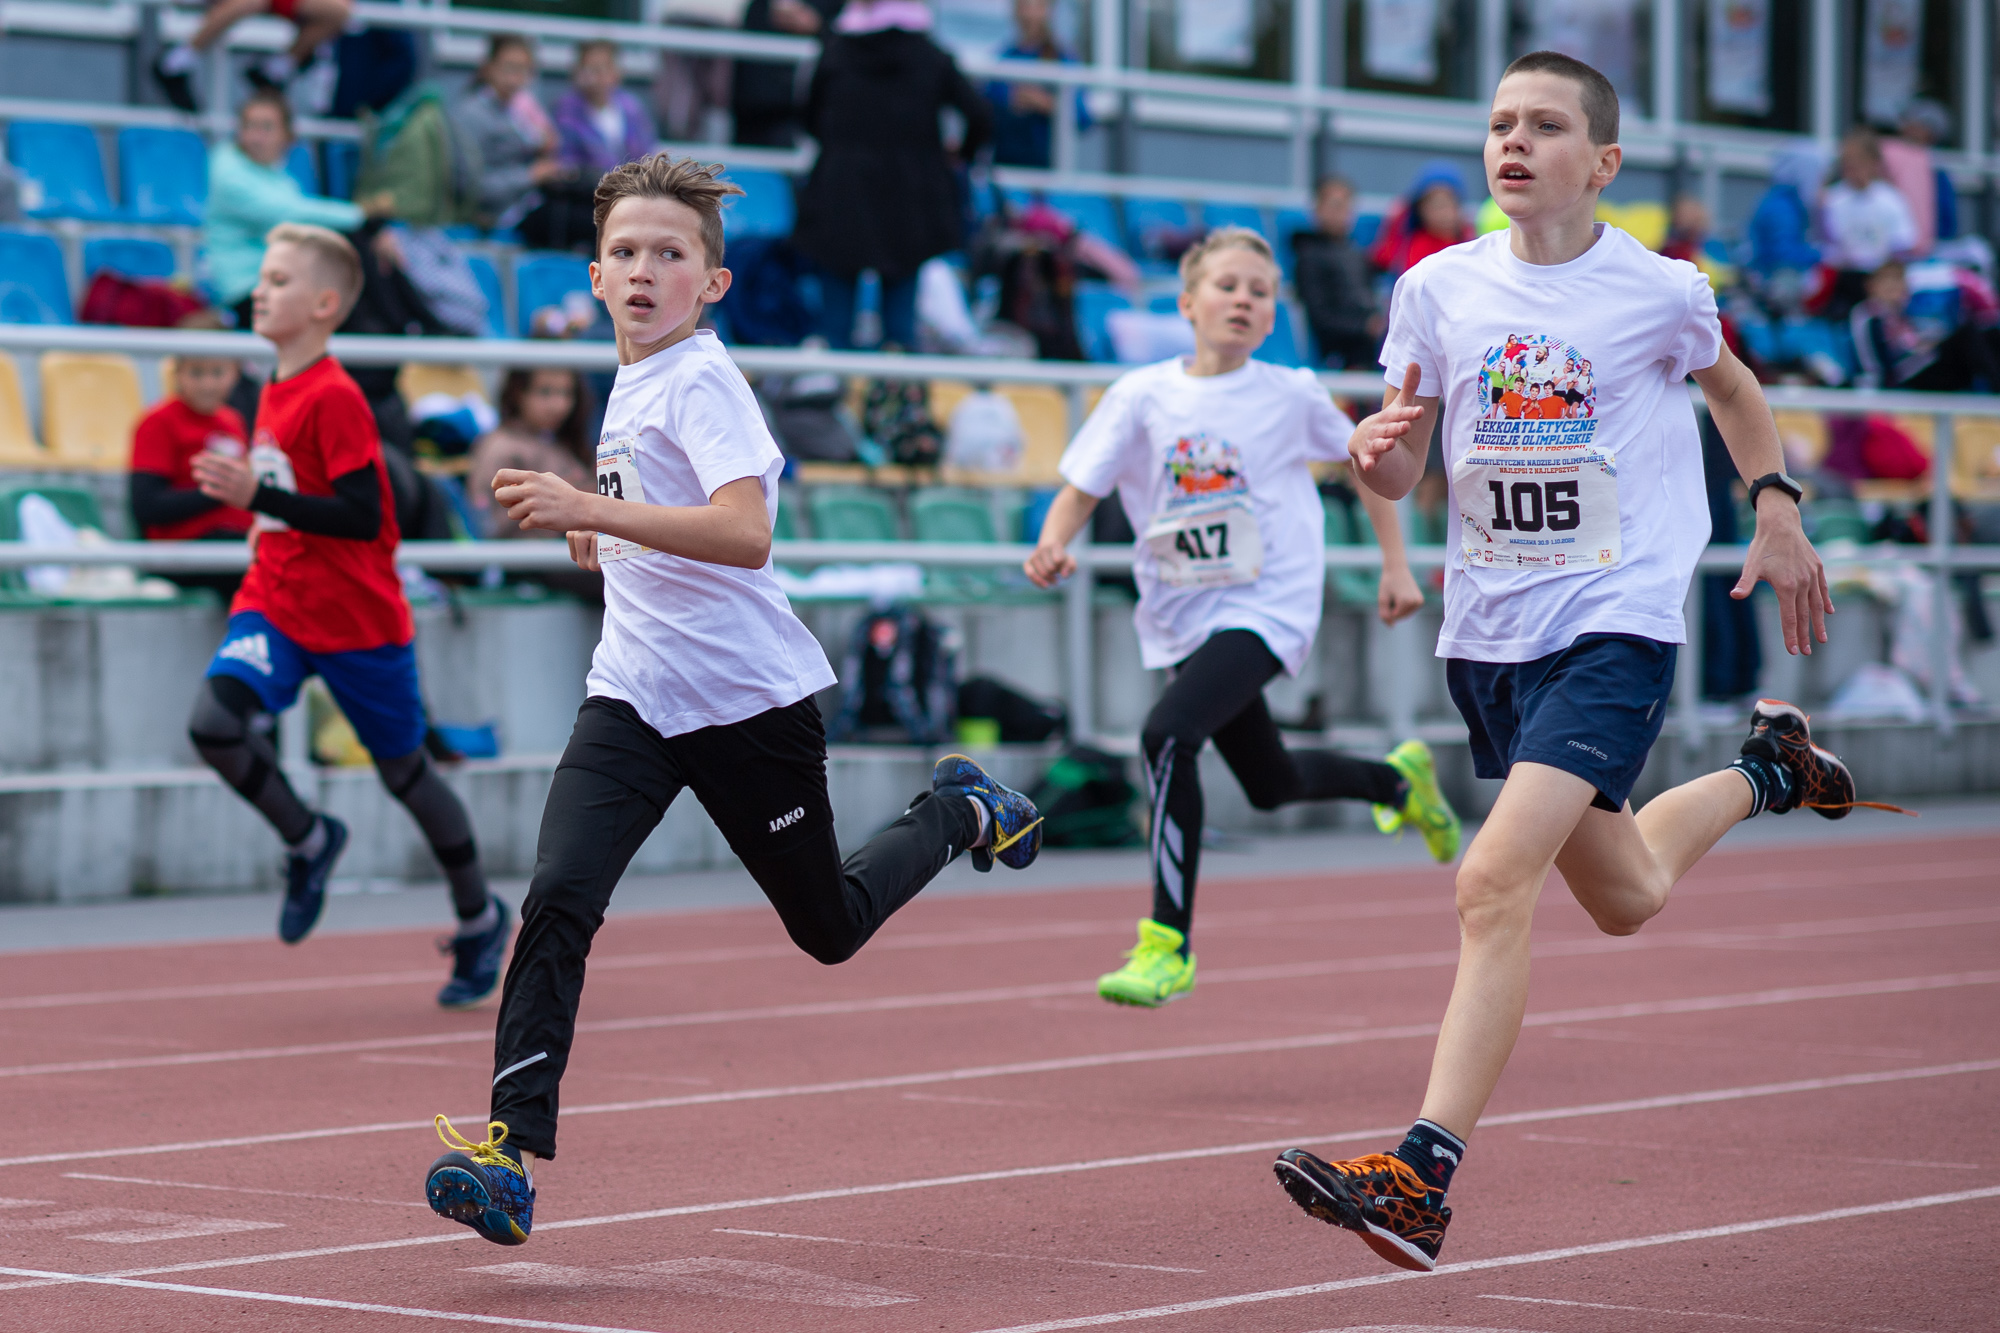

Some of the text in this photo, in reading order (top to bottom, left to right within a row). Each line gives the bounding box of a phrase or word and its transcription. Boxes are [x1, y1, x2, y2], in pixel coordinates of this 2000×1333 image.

[1475, 419, 1599, 434] LEKKOATLETYCZNE
[1472, 433, 1593, 446] NADZIEJE OLIMPIJSKIE
[1466, 454, 1605, 467] LEKKOATLETYCZNE NADZIEJE OLIMPIJSKIE
[1534, 465, 1579, 474] NAJLEPSZYCH
[1488, 480, 1581, 532] 105
[1176, 523, 1229, 560] 417
[1522, 555, 1551, 563] FUNDACJA
[1567, 740, 1608, 761] martes
[769, 806, 805, 833] JAKO
